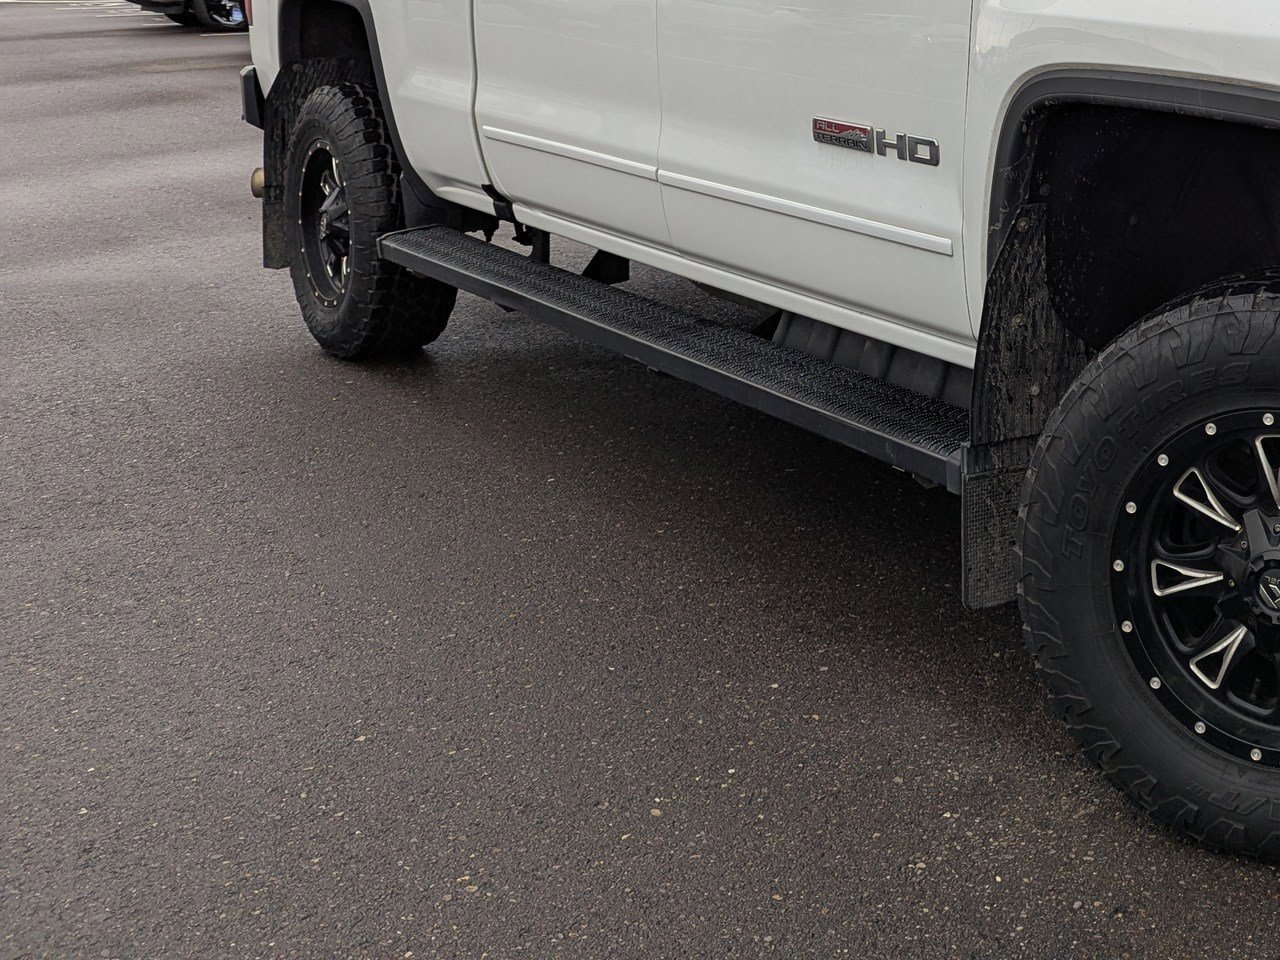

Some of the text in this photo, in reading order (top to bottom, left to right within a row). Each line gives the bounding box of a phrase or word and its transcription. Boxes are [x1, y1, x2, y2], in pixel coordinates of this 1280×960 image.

[816, 120, 840, 133] ALL
[875, 128, 941, 167] HD
[1062, 361, 1253, 560] TOYO TIRES
